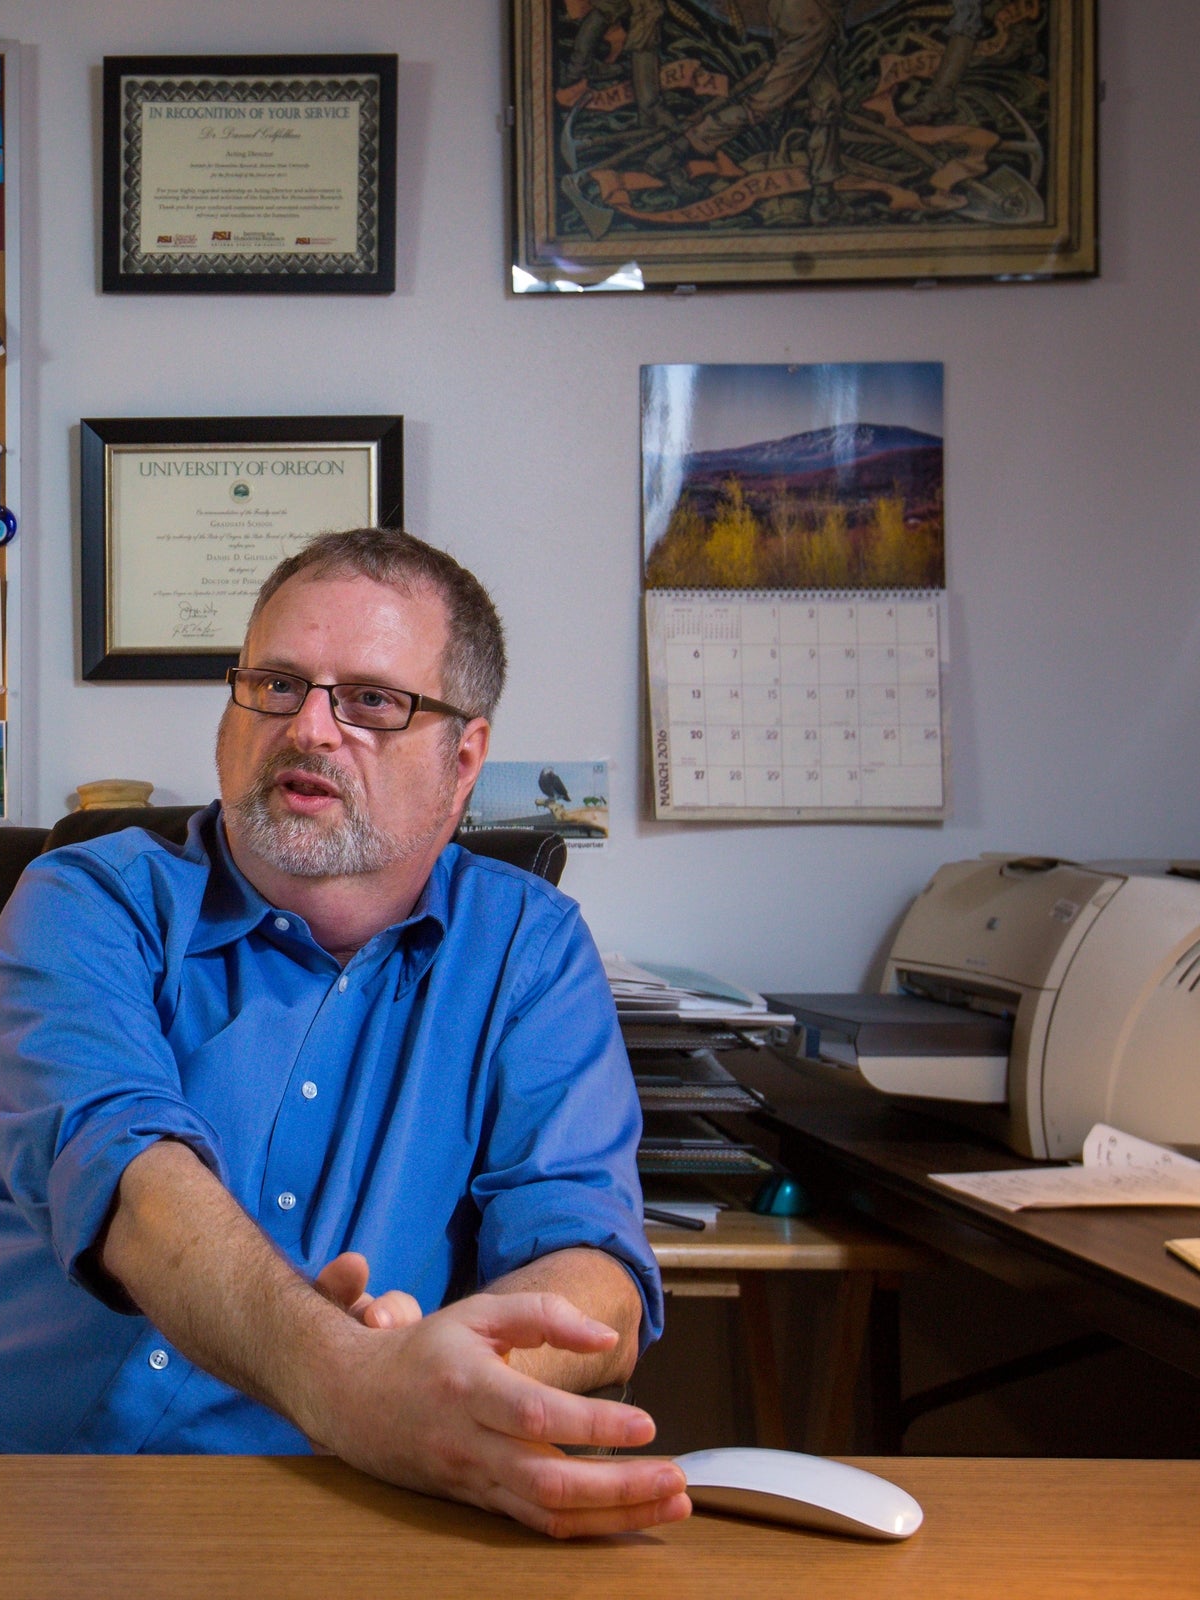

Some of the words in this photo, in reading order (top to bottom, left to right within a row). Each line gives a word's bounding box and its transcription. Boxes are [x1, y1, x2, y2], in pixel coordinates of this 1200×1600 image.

[149, 107, 162, 119] IN
[166, 107, 245, 120] RECOGNITION
[249, 107, 264, 119] OF
[268, 107, 301, 119] YOUR
[305, 107, 350, 119] SERVICE
[157, 235, 172, 243] ASU
[211, 231, 231, 241] ASU
[295, 237, 311, 245] ASU
[139, 461, 245, 477] UNIVERSITY
[246, 461, 270, 475] OF
[271, 460, 345, 475] OREGON
[206, 553, 230, 561] DANIEL
[233, 553, 242, 561] D.
[244, 553, 278, 561] GILFILLAN
[201, 577, 230, 585] DOCTOR
[242, 577, 264, 585] PHILO
[657, 730, 669, 760] 2016
[659, 762, 671, 807] MARCH
